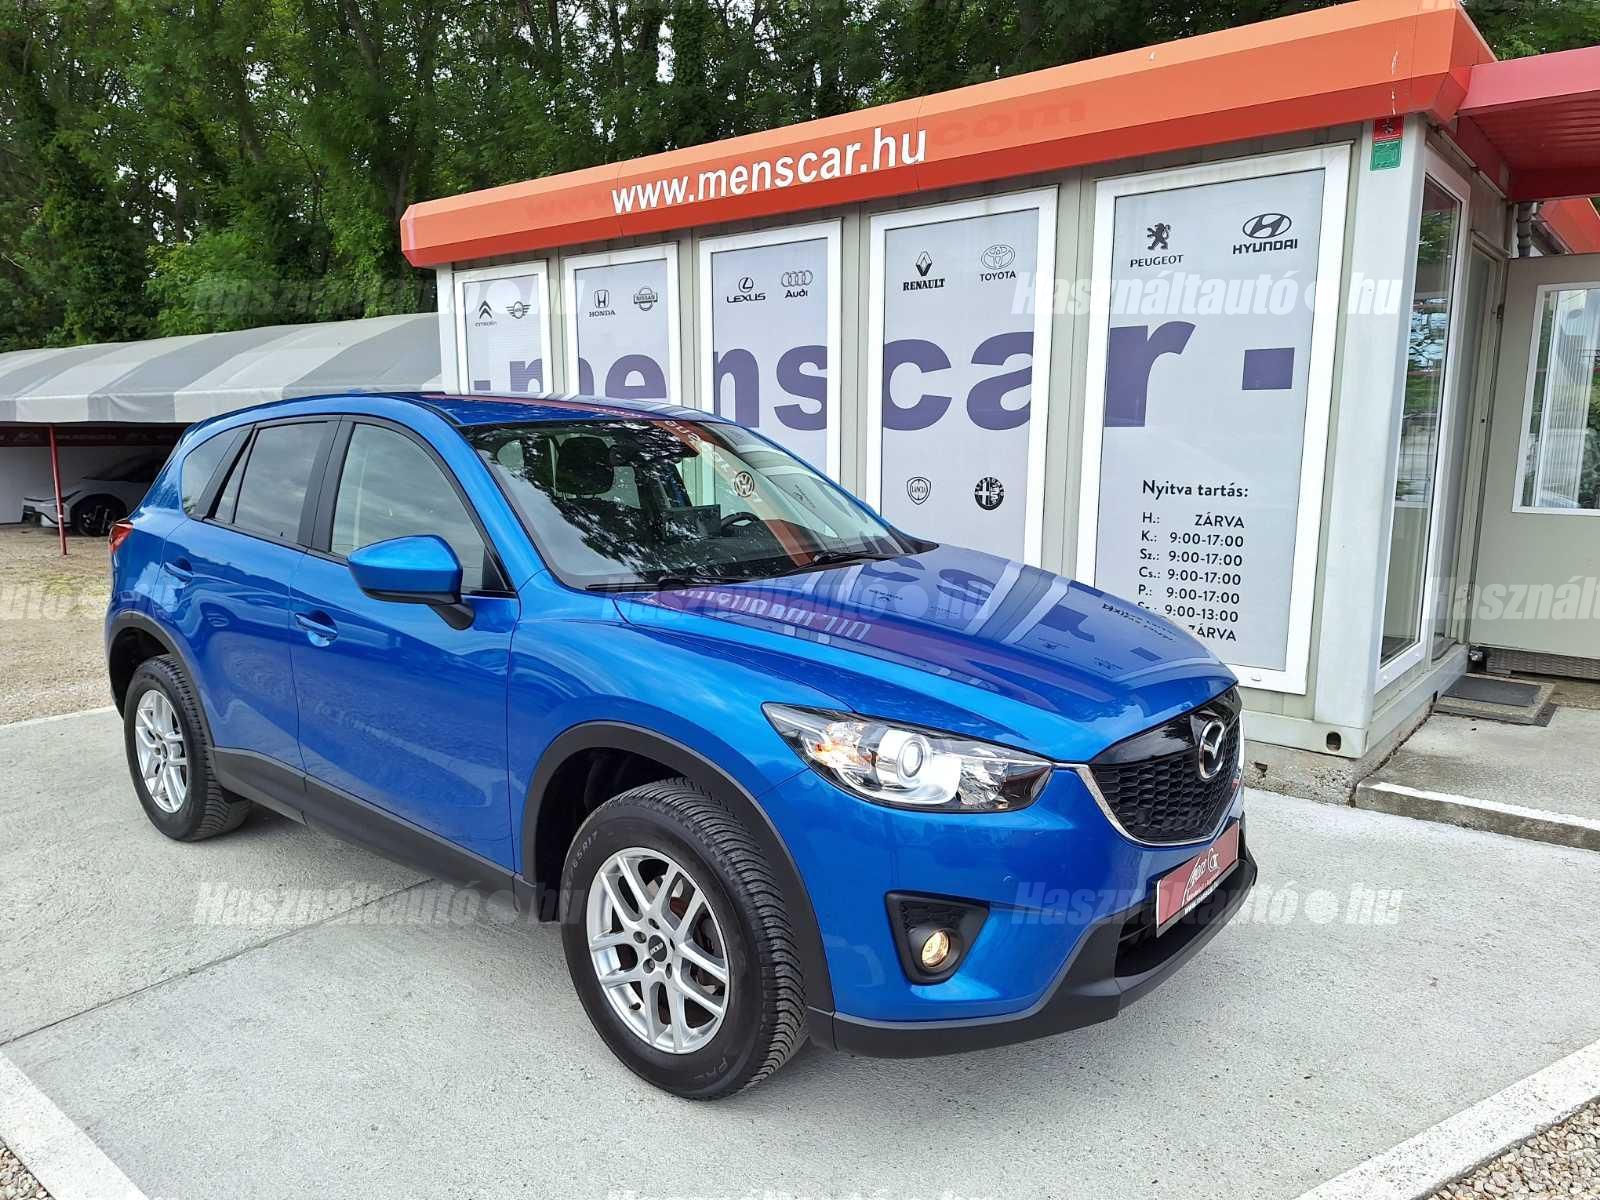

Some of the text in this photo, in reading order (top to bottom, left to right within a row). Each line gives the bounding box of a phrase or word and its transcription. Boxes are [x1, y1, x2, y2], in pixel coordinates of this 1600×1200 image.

[611, 126, 928, 215] www.menscar.hu
[1232, 238, 1298, 255] HYUNDAI
[1129, 254, 1184, 268] PEUGEOT
[902, 278, 946, 291] RENAULT
[979, 270, 1017, 282] TOYOTA
[726, 292, 767, 304] LEXUS
[784, 288, 808, 298] Audi
[588, 310, 616, 318] HONDA
[1141, 479, 1249, 500] Nyitva tartás:
[1142, 511, 1245, 529] H.: ZÁRVA
[1141, 530, 1244, 548] K.: 9:00-17:00
[1139, 548, 1243, 567] Sz.: 9:00-17:00
[1138, 566, 1241, 586] Cs.: 9:00-17:00
[1137, 584, 1152, 597] P.:
[1166, 587, 1240, 605] 9:00-17:00
[1164, 604, 1239, 623] 9:00-13:00
